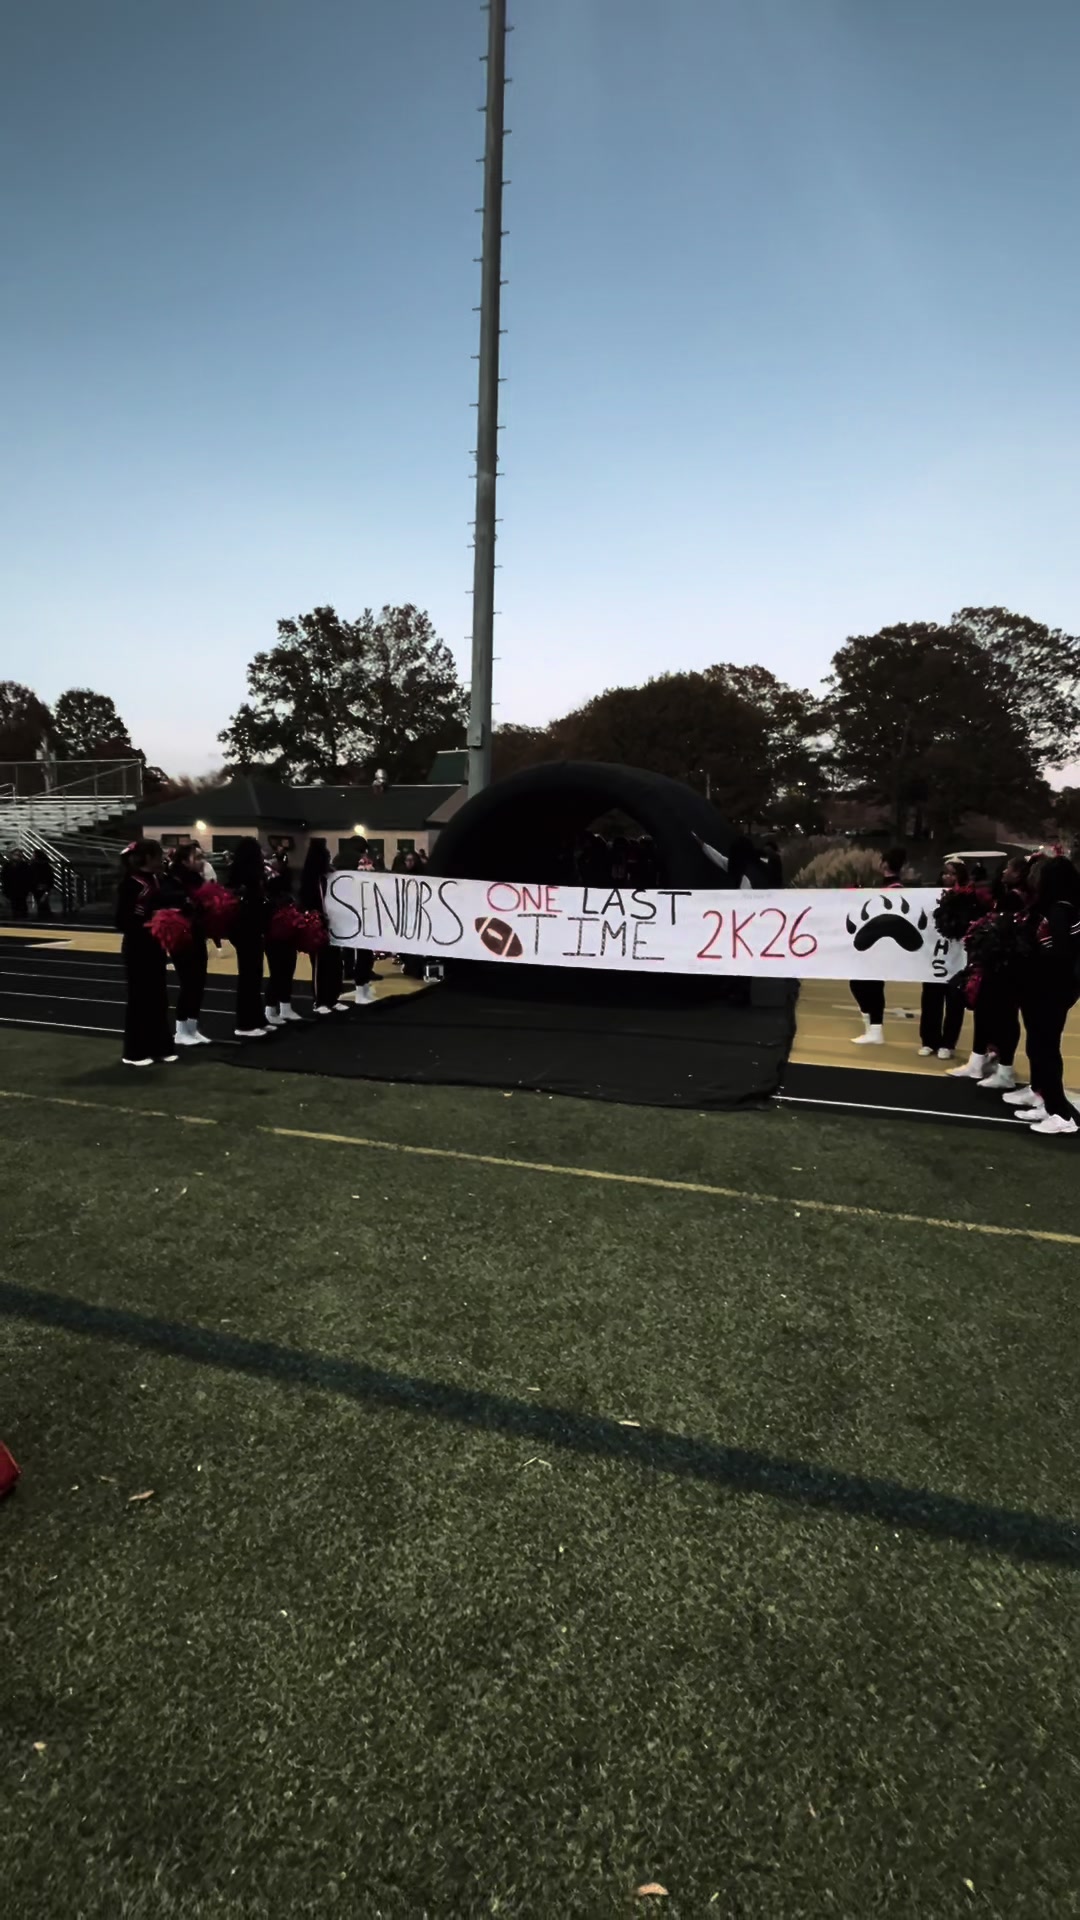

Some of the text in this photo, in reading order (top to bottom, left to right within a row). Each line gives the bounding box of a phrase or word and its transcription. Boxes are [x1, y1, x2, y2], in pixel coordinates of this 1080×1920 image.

[329, 875, 692, 946] SENIORS ONE LAST
[516, 913, 665, 960] TIME
[696, 906, 818, 959] 2K26
